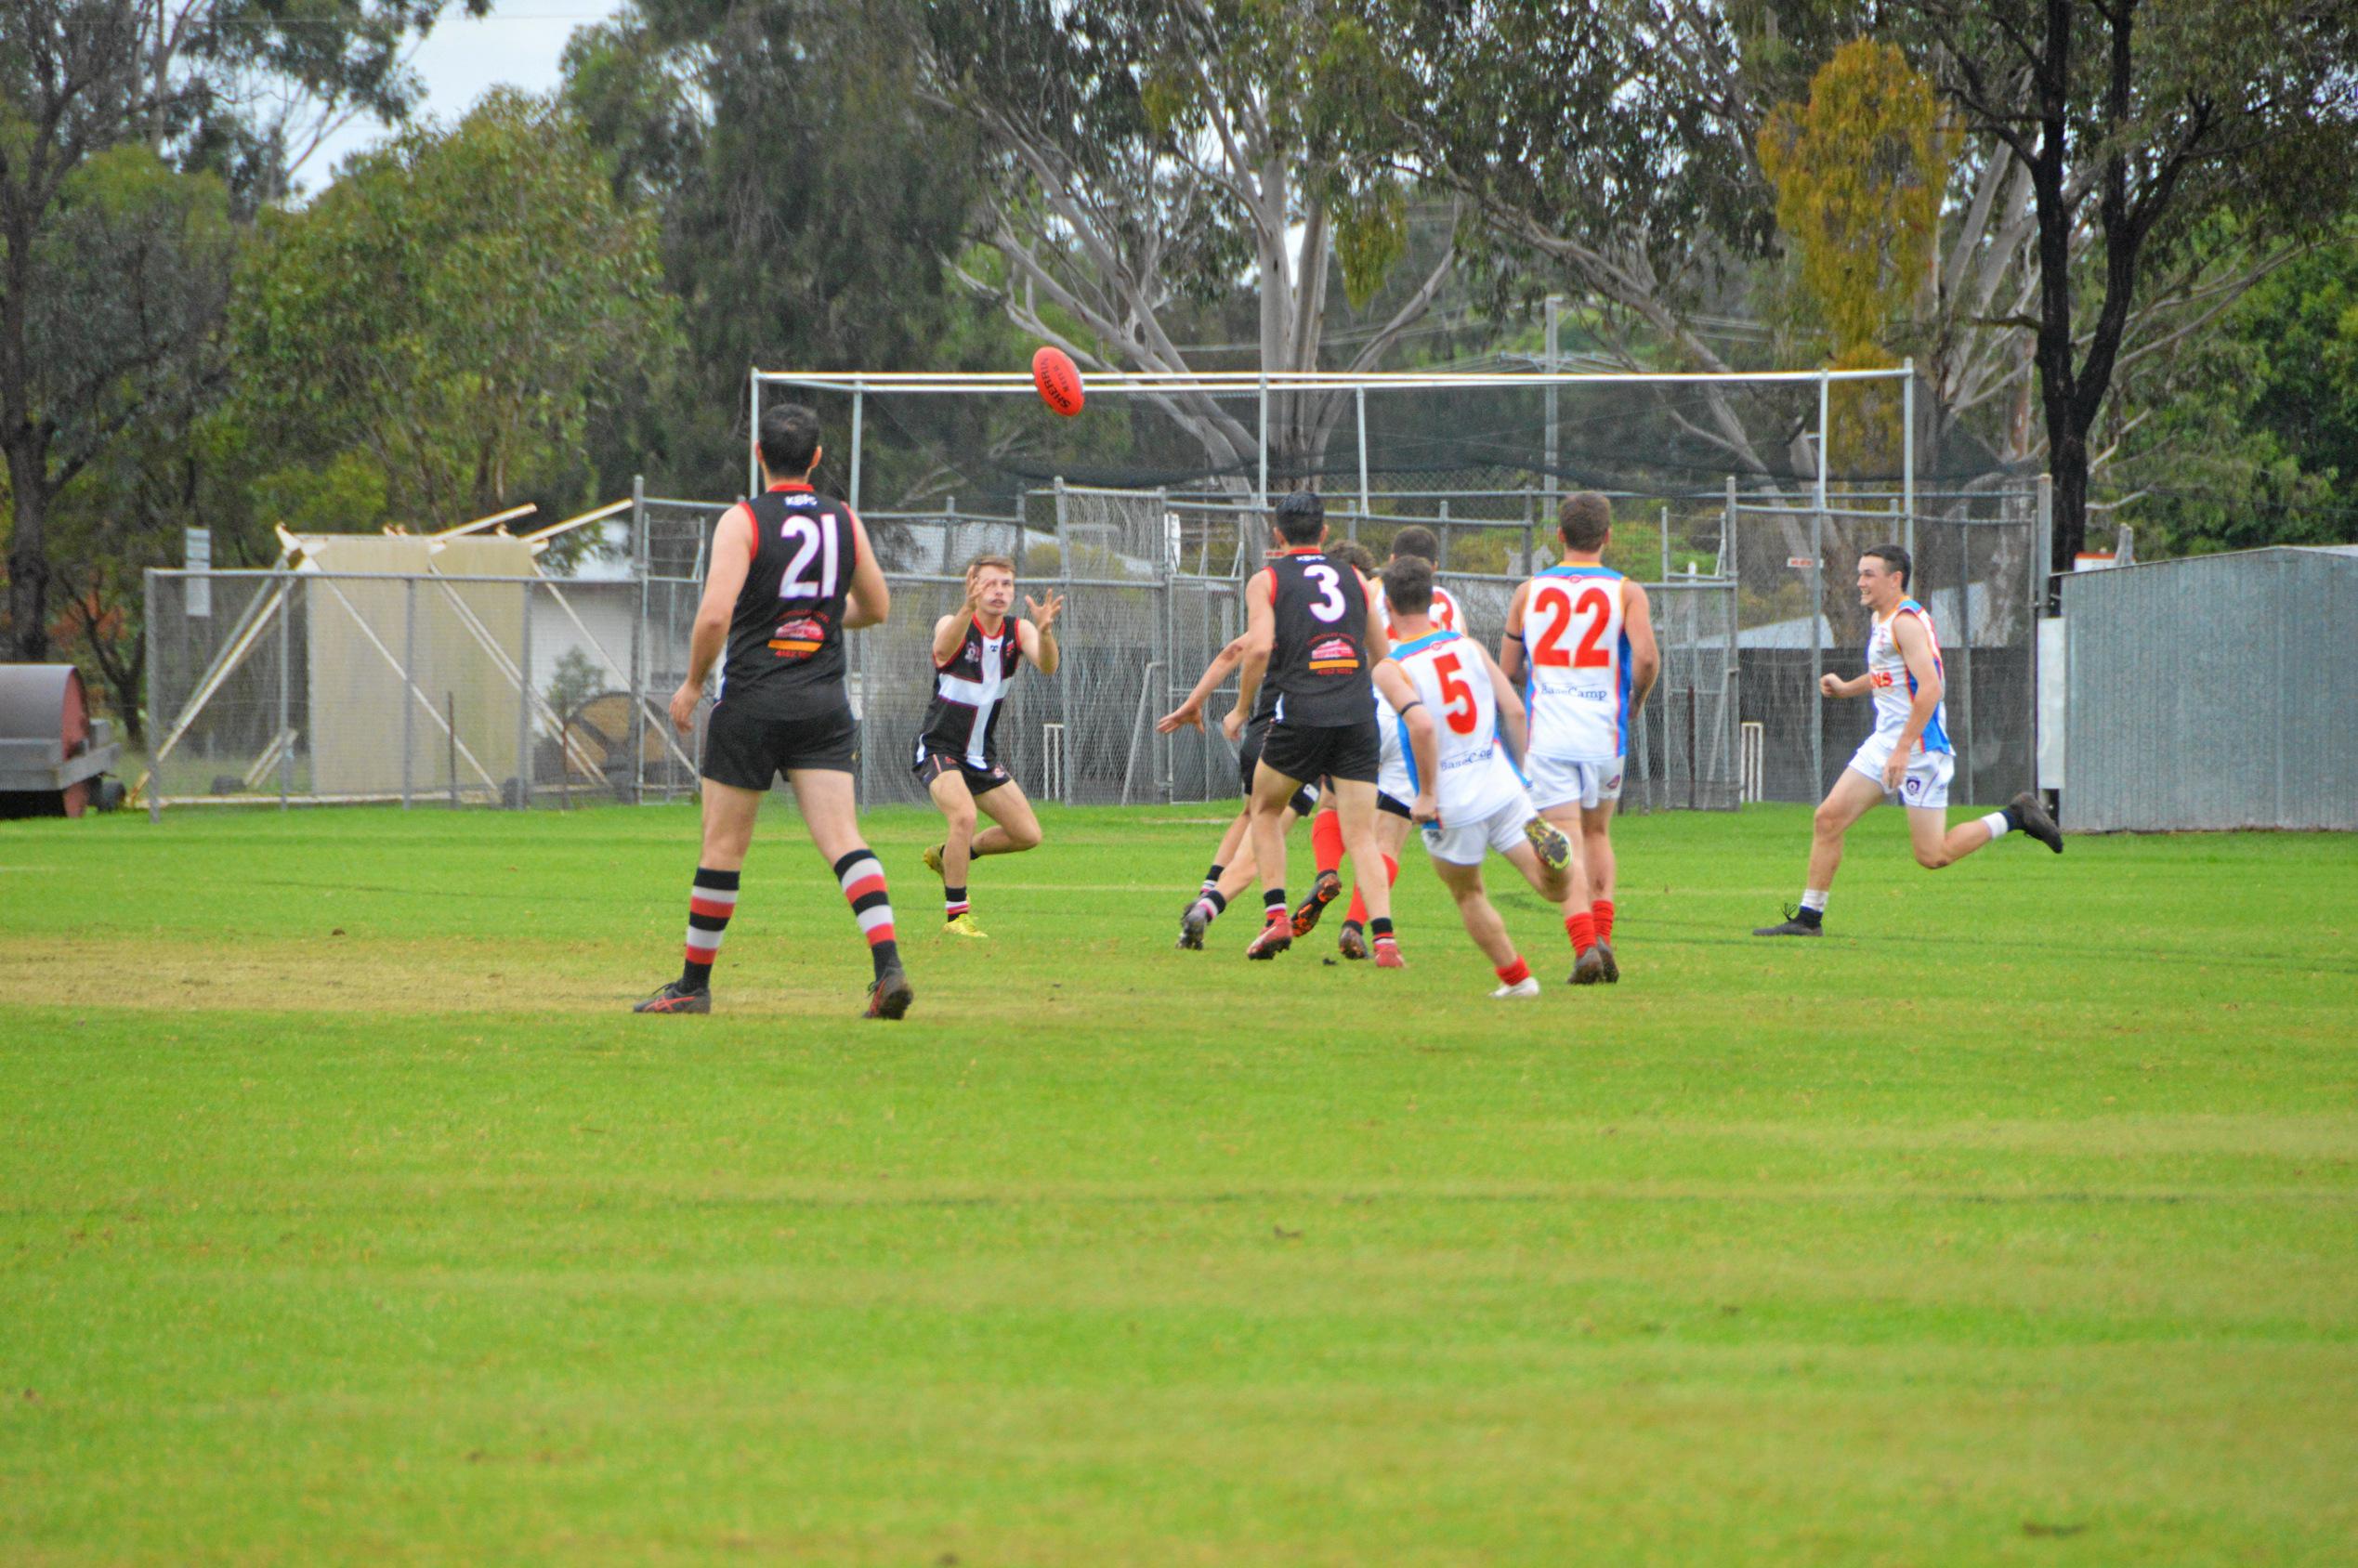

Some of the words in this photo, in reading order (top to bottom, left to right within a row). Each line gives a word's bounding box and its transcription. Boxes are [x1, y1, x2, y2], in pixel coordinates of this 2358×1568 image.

[1040, 358, 1071, 408] SHERRIN
[779, 513, 838, 598] 21
[1303, 564, 1346, 622] 3
[1533, 587, 1612, 668] 22
[1433, 652, 1477, 735] 5
